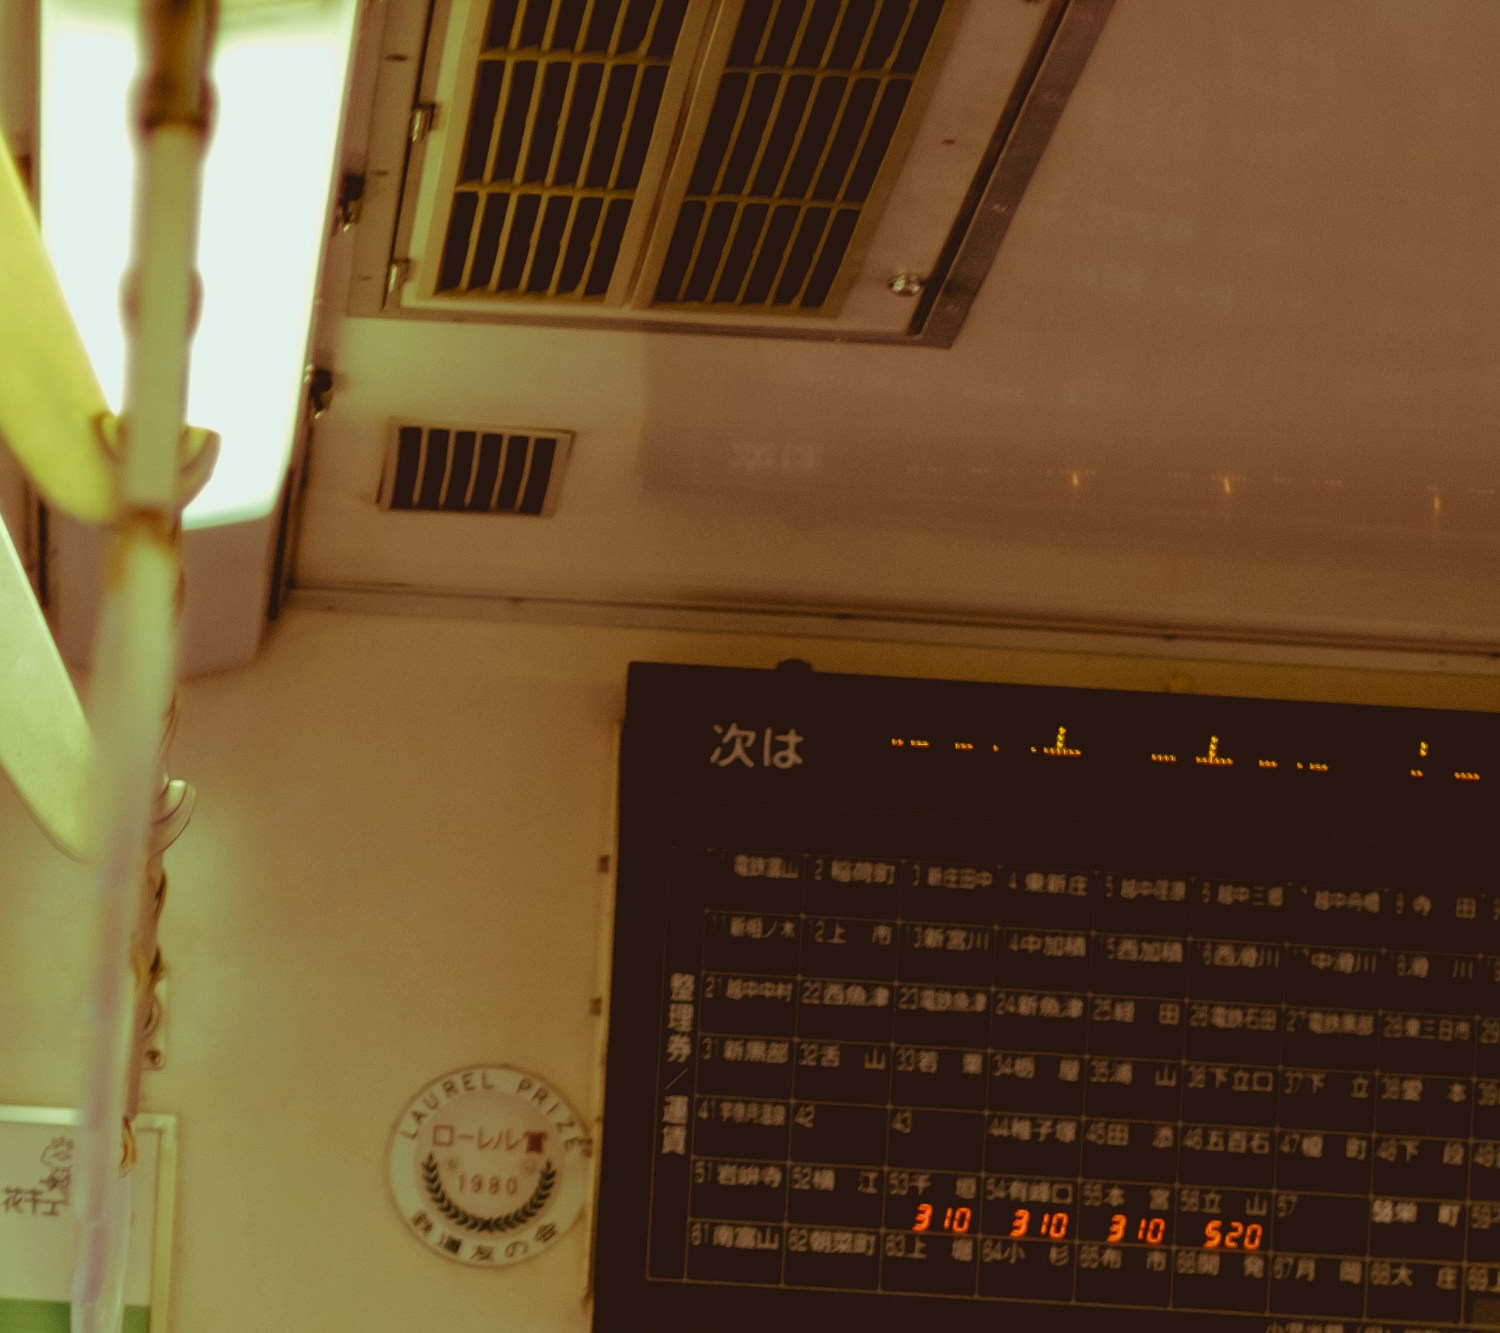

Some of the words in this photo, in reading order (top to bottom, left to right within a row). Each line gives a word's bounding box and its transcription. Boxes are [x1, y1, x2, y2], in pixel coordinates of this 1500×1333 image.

[400, 1071, 496, 1141] LAUREL
[515, 1077, 584, 1151] PRIZE
[457, 1173, 519, 1196] 1980
[912, 1203, 972, 1234] 310
[1009, 1209, 1069, 1239] 310
[1106, 1214, 1166, 1244] 310
[1204, 1219, 1263, 1249] 520
